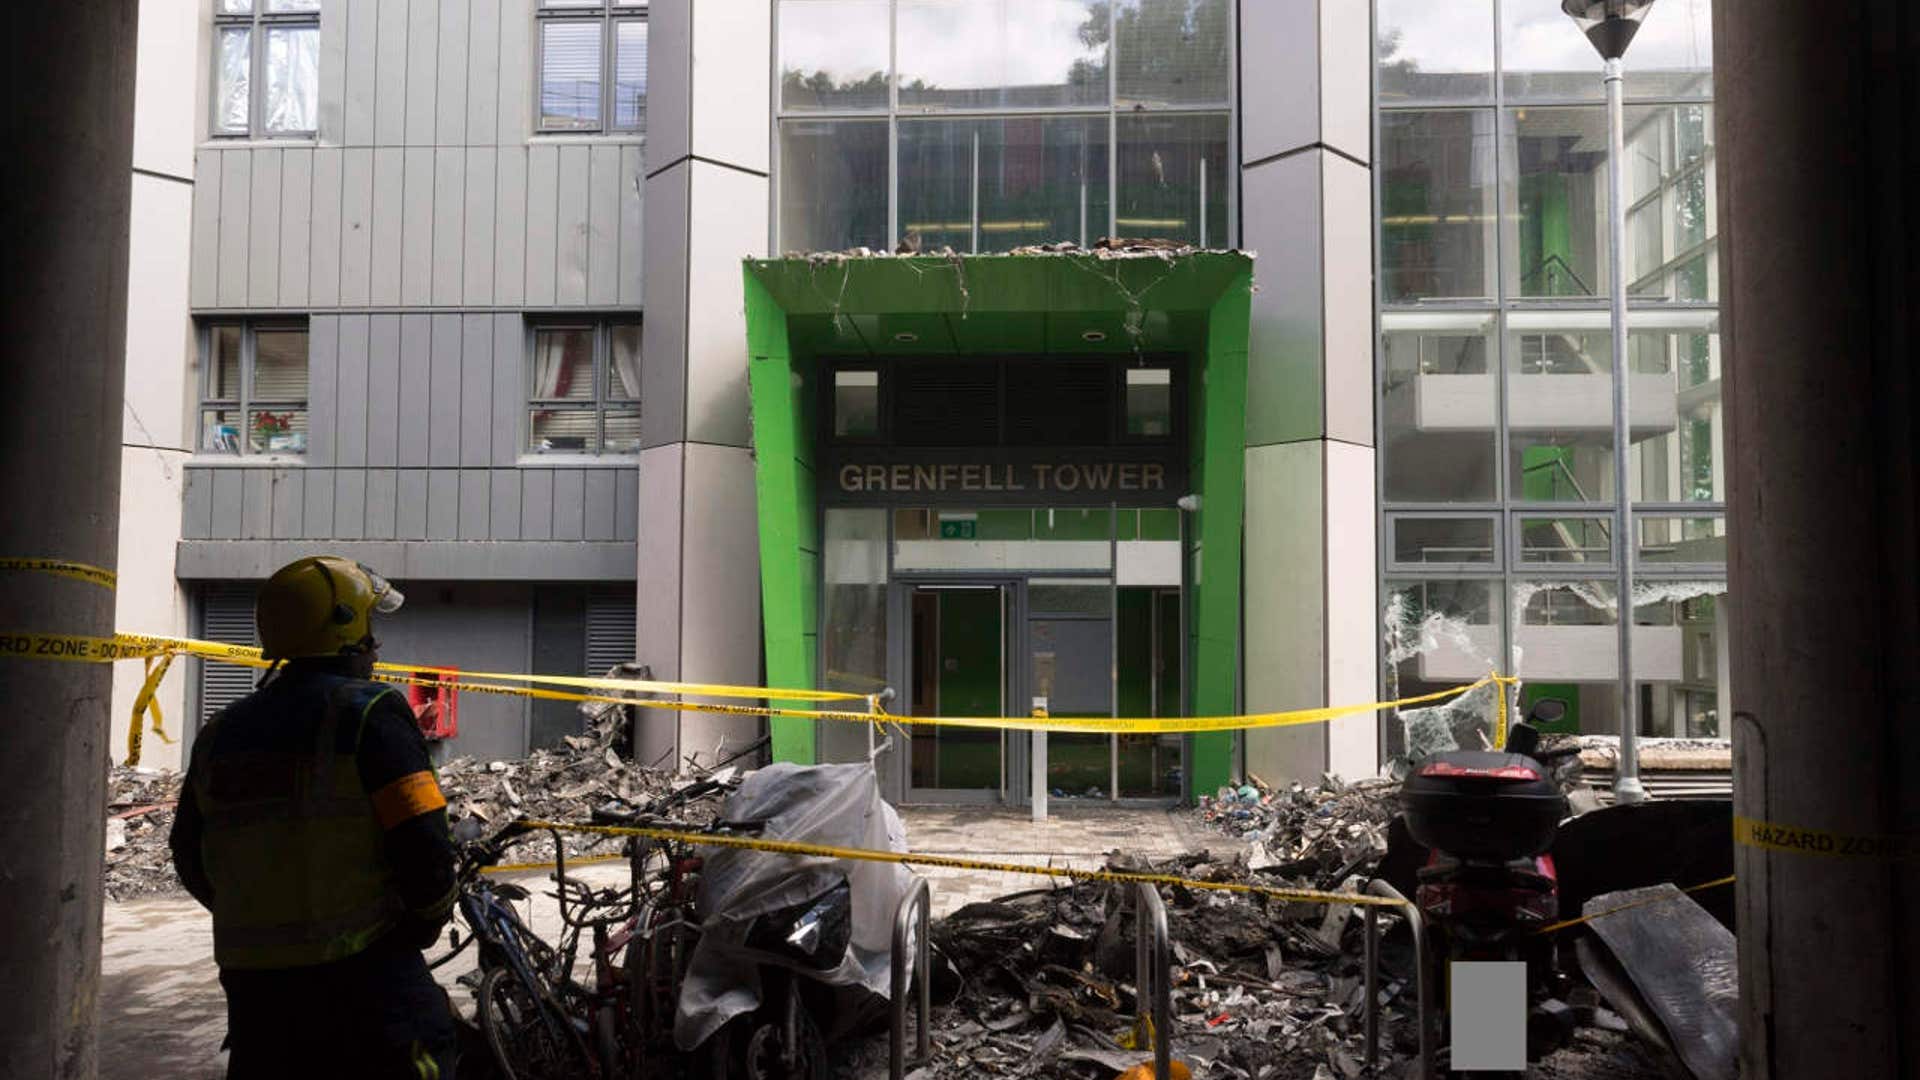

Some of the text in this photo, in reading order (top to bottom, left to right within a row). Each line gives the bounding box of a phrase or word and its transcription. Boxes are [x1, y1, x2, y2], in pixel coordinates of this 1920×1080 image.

[840, 463, 1165, 491] GRENFELL TOWER
[36, 637, 89, 656] ZONE
[100, 642, 118, 658] DO
[1751, 823, 1834, 852] HAZARD
